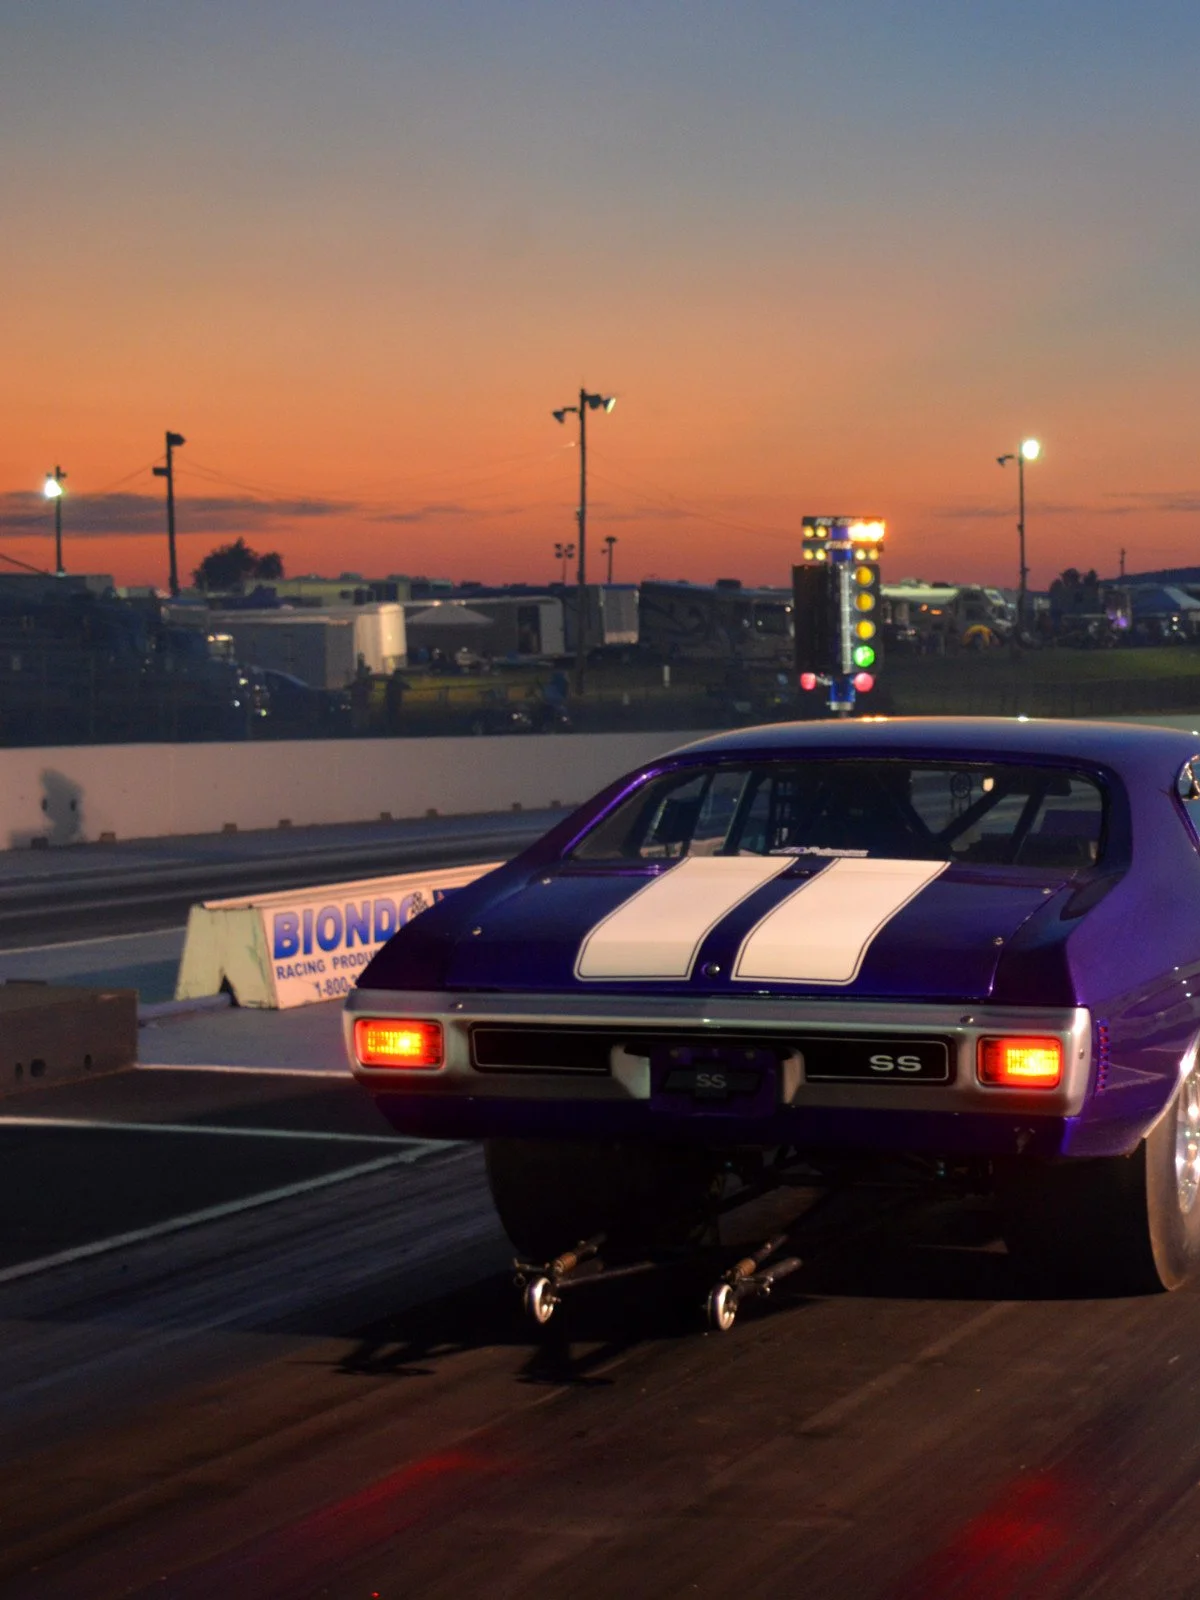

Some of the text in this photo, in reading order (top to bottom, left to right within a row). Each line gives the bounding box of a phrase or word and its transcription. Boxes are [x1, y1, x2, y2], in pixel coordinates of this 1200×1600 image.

[276, 950, 377, 979] RACING PRODU
[869, 1054, 922, 1072] SS
[696, 1073, 727, 1089] SS
